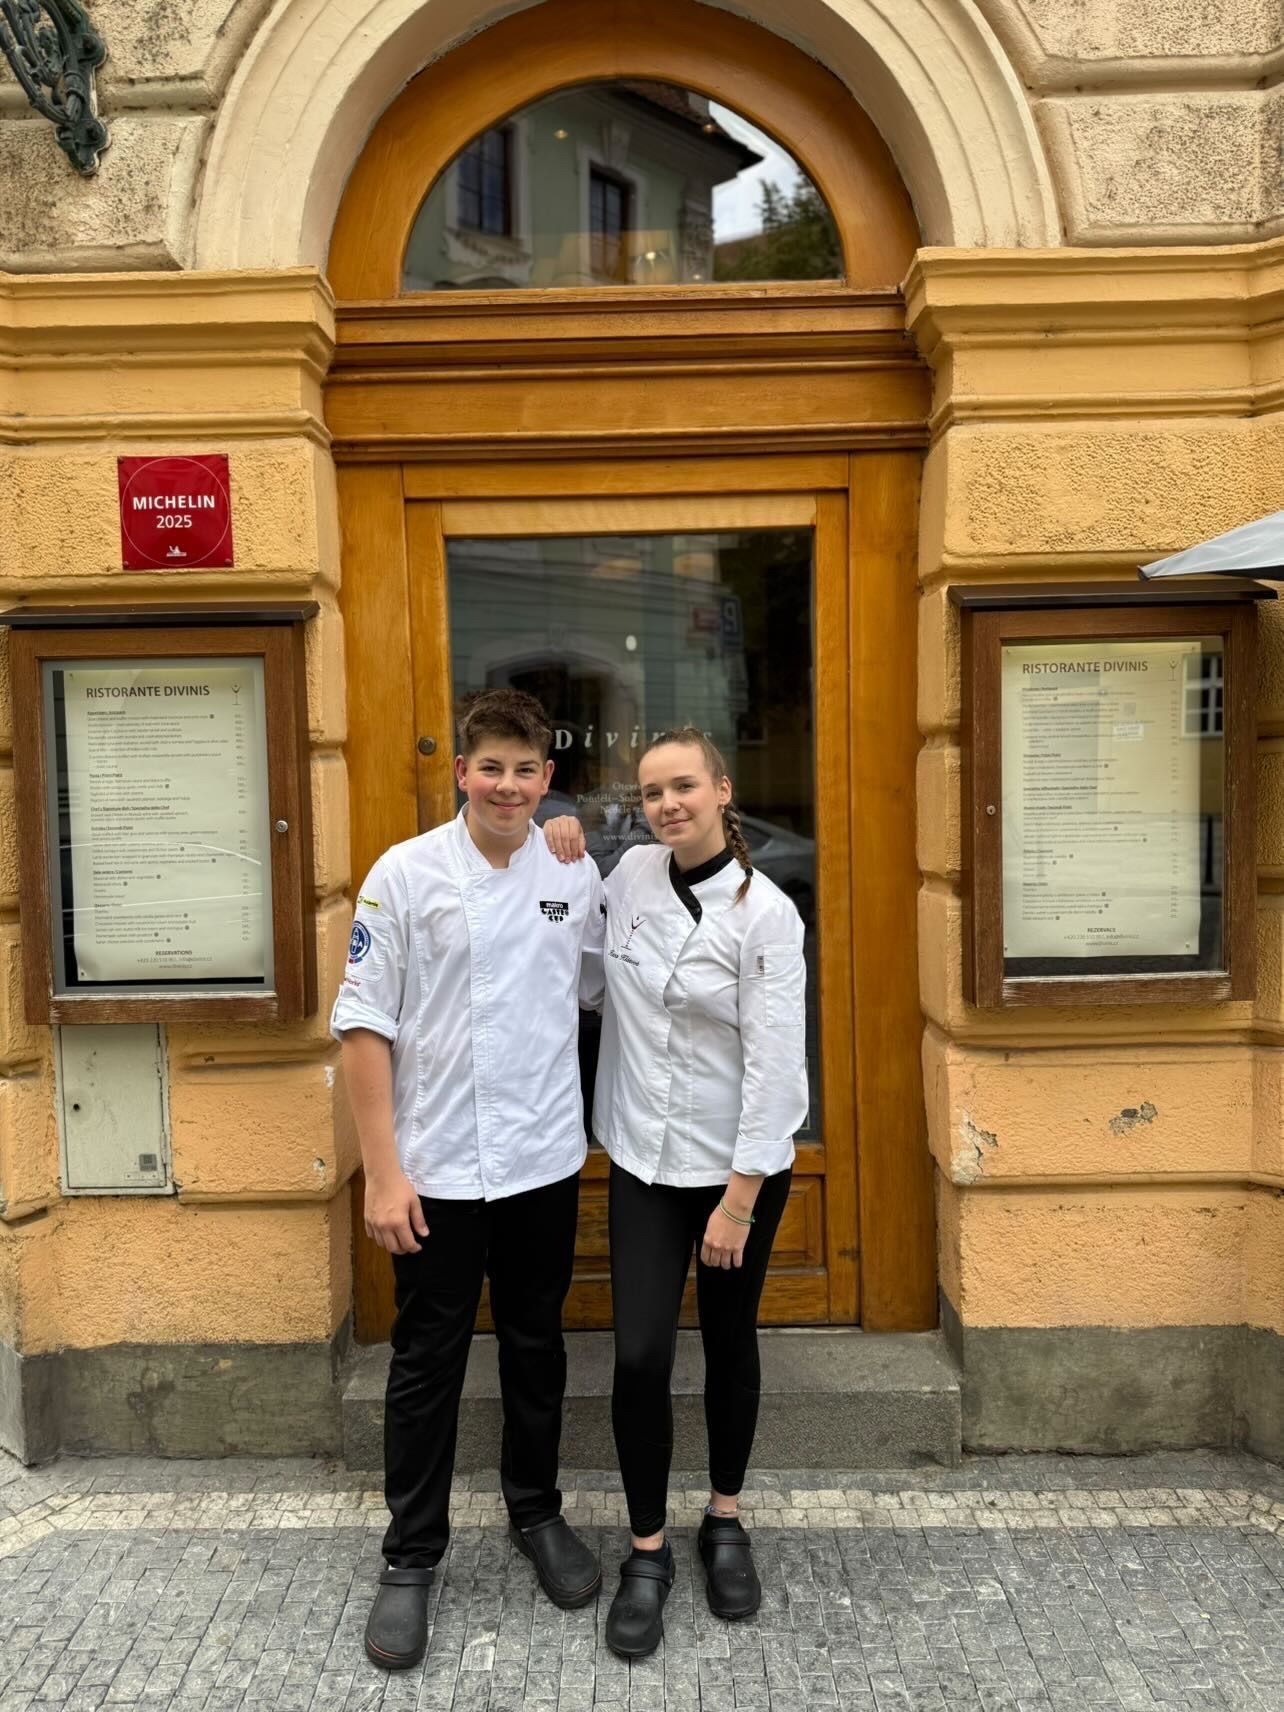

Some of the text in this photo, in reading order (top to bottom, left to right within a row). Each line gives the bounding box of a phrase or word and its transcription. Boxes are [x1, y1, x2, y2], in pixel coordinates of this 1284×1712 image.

[133, 495, 215, 510] MICHELIN
[156, 515, 192, 529] 2025
[1022, 660, 1148, 674] RISTORANTE DIVINIS
[86, 685, 210, 698] RISTORANTE DIVINIS
[602, 830, 656, 841] www.divini
